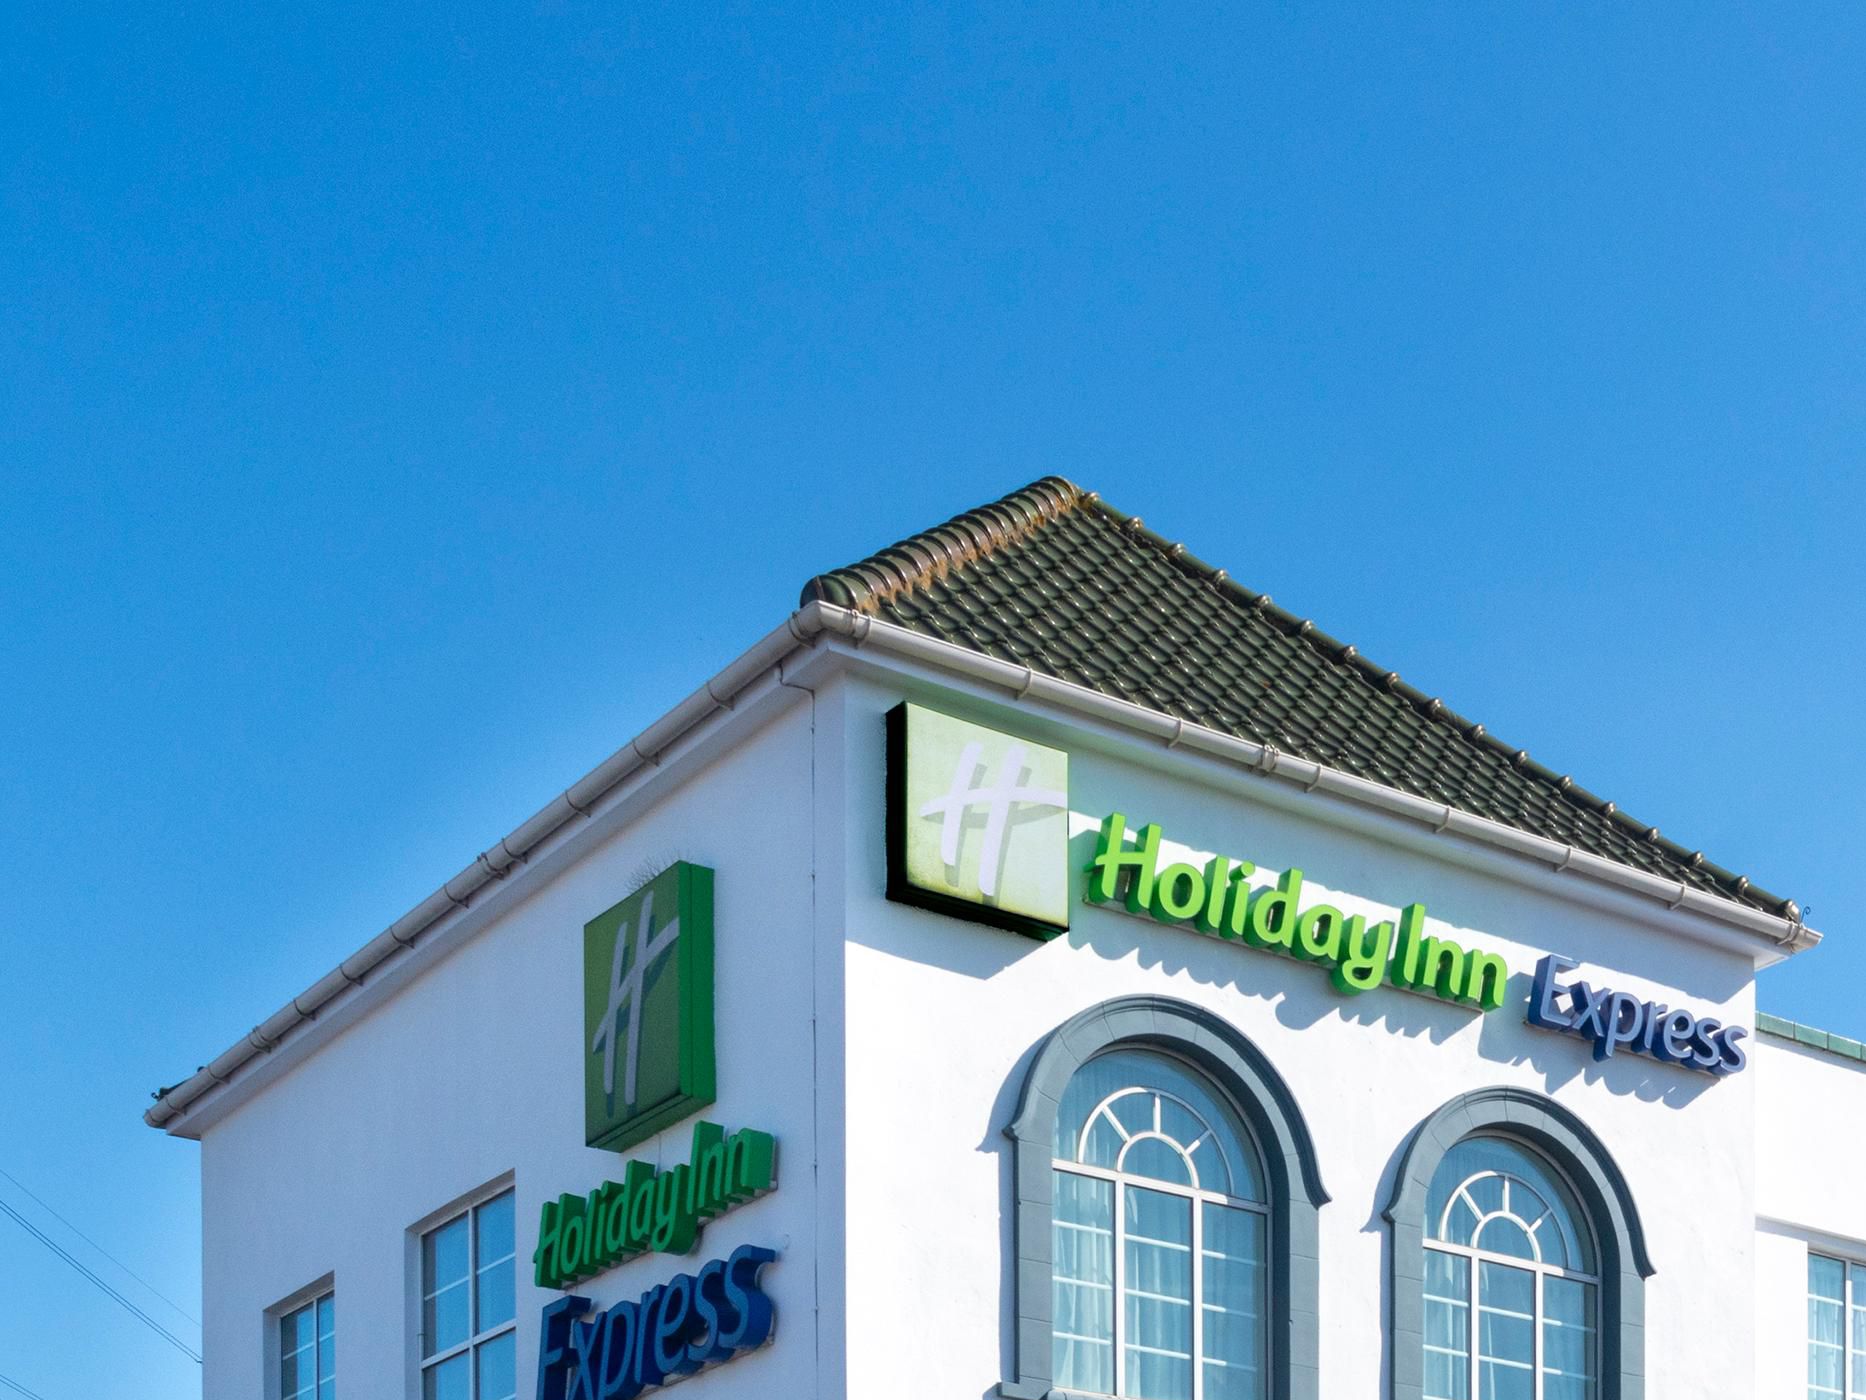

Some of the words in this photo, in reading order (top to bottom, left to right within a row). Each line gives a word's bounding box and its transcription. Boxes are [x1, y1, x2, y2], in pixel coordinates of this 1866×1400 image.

[1086, 812, 1394, 995] Holiday
[1394, 903, 1508, 1010] Inn
[1528, 955, 1748, 1076] Express
[533, 1158, 698, 1290] Holiday
[688, 1120, 775, 1216] Inn
